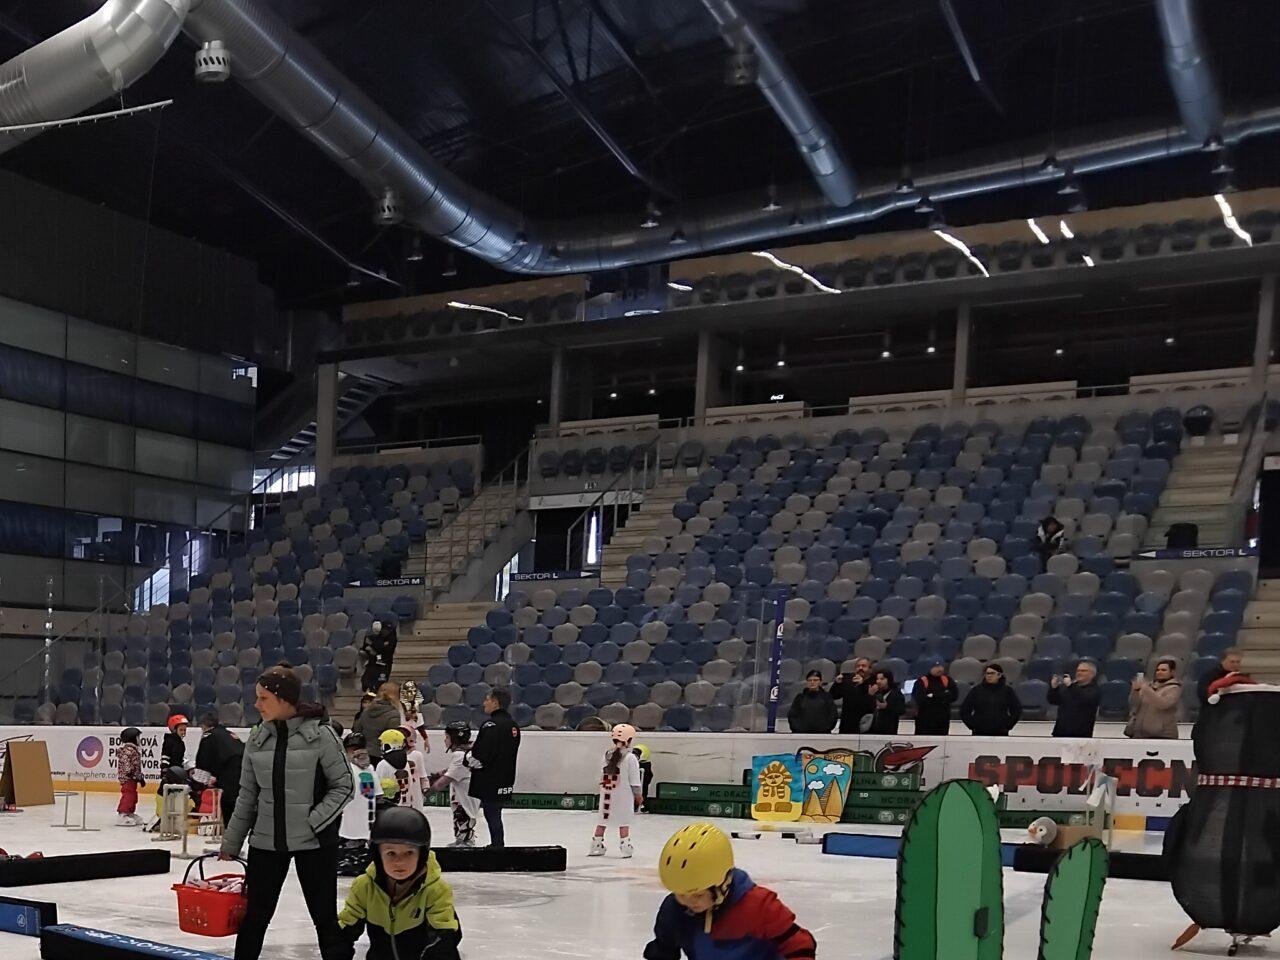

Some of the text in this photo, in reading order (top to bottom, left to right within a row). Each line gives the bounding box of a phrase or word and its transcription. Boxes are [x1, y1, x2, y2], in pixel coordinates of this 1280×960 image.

[1183, 548, 1247, 558] SEKTOR L
[377, 578, 420, 587] SEKTOR M
